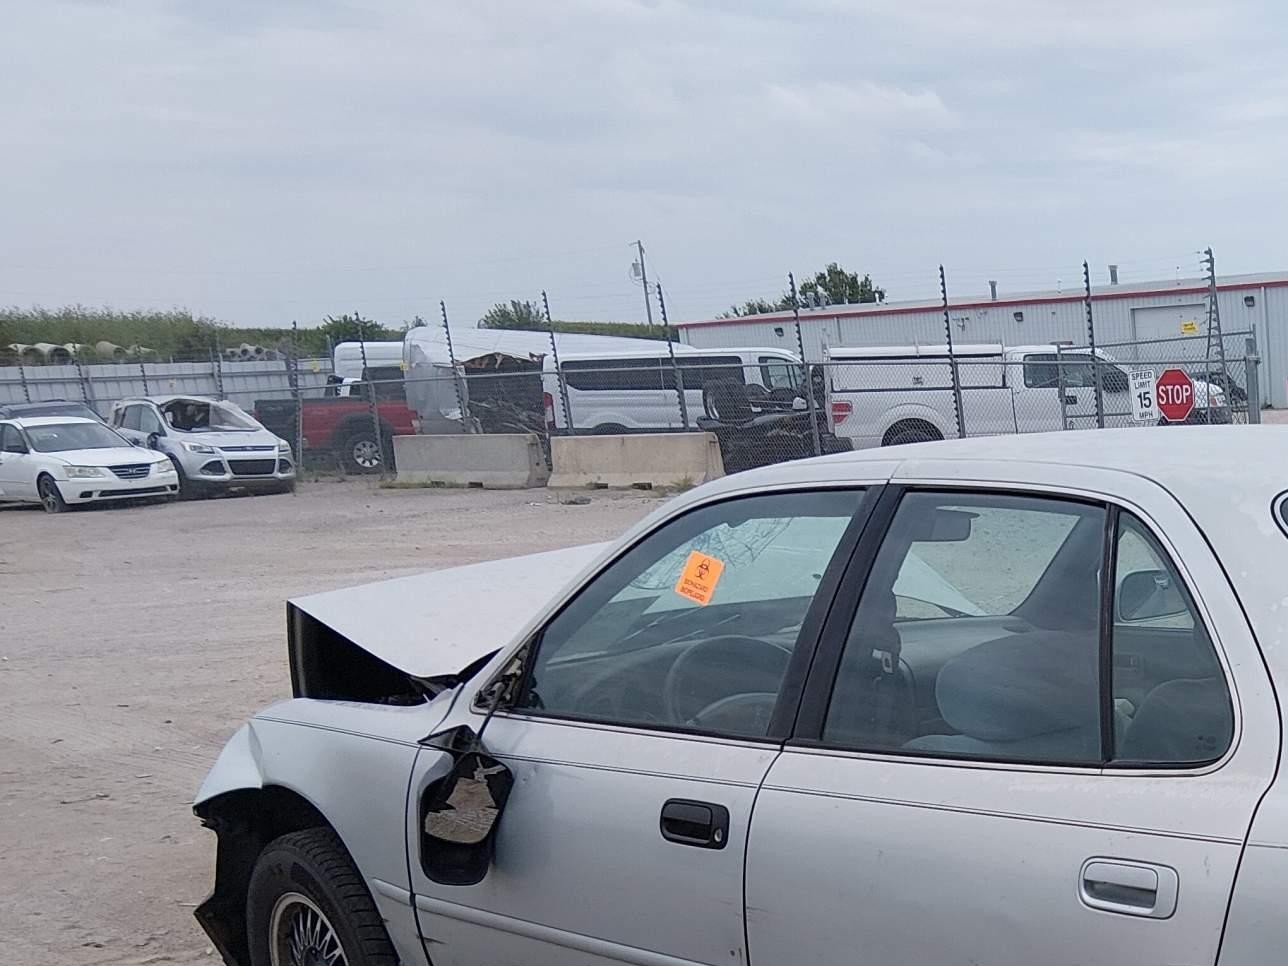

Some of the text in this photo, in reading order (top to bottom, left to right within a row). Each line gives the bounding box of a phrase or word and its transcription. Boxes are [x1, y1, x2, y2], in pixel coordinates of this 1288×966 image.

[1131, 371, 1152, 380] SPEED
[1134, 380, 1151, 389] LIMIT
[1158, 384, 1191, 405] STOP
[1137, 391, 1152, 409] 15
[1138, 410, 1153, 419] MPH
